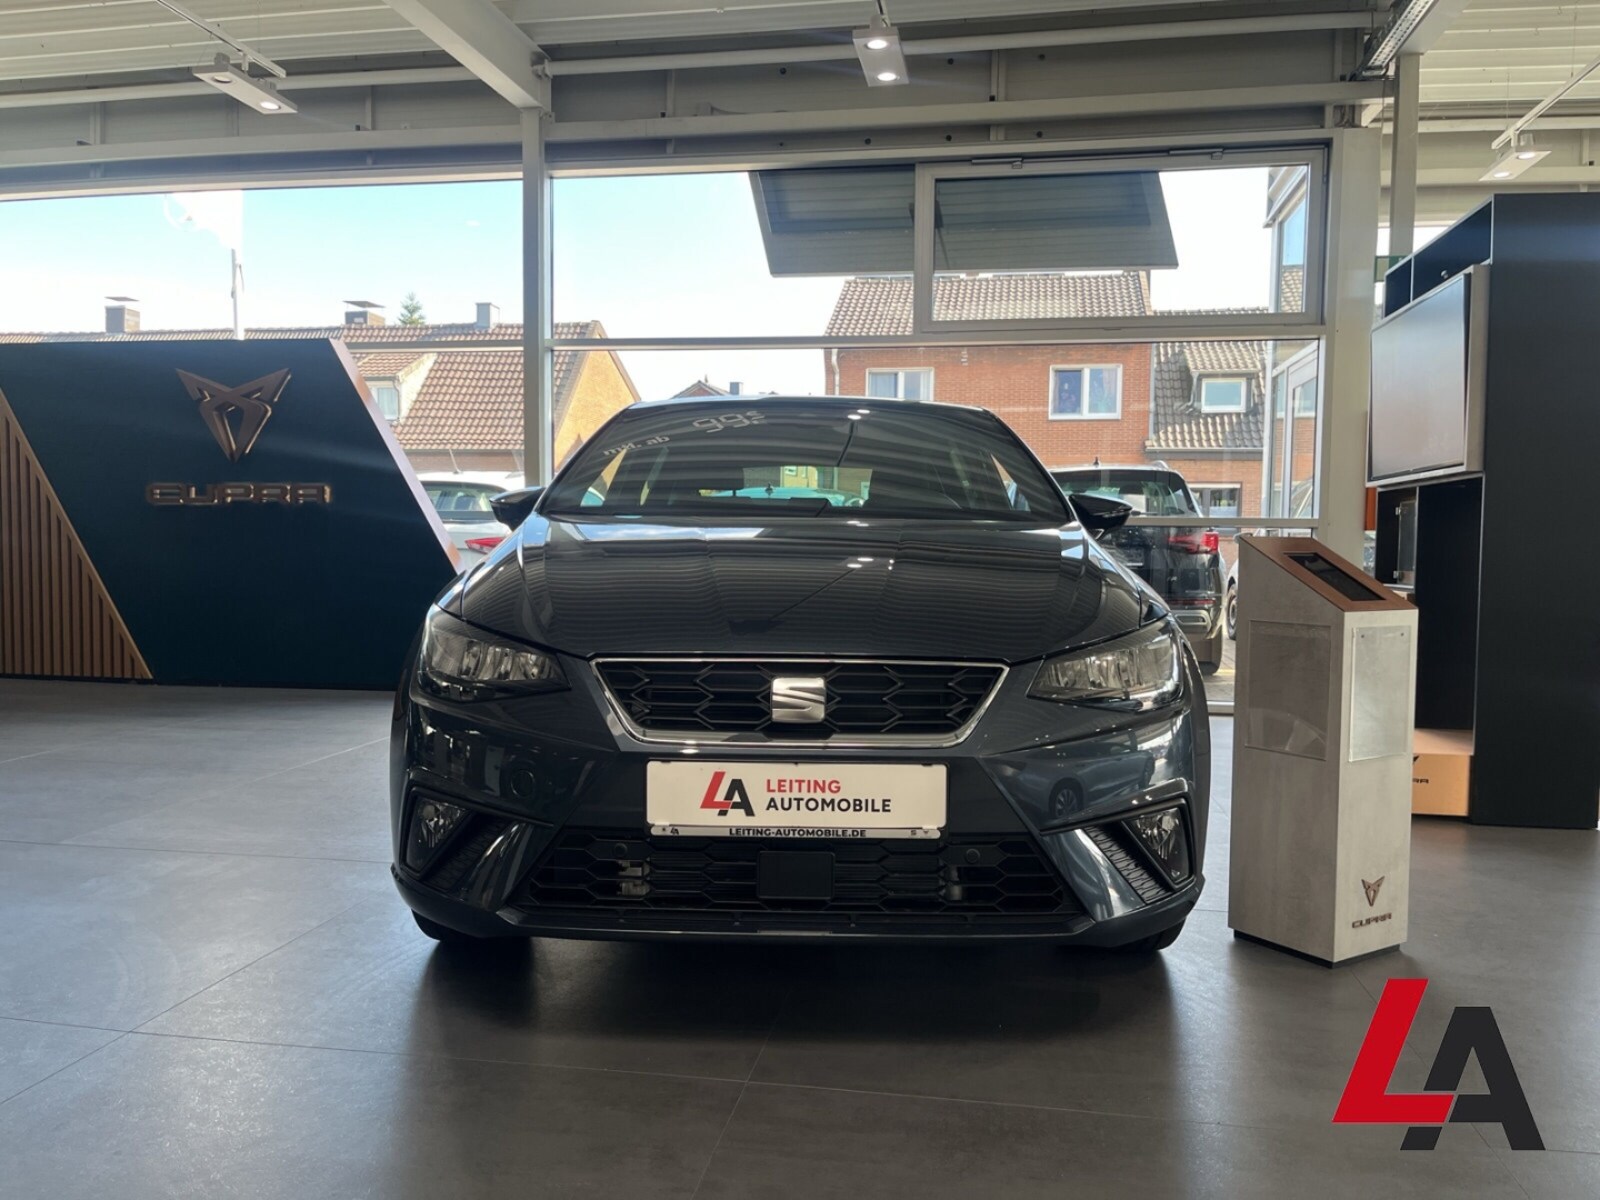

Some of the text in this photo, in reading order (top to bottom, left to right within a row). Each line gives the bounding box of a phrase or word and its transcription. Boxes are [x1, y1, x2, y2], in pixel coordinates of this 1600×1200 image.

[147, 482, 331, 506] CUPRA
[766, 779, 842, 794] LEITING
[765, 797, 892, 813] AUTOMOBILE
[729, 828, 867, 838] LEITING-AUTOMOBILE.DE
